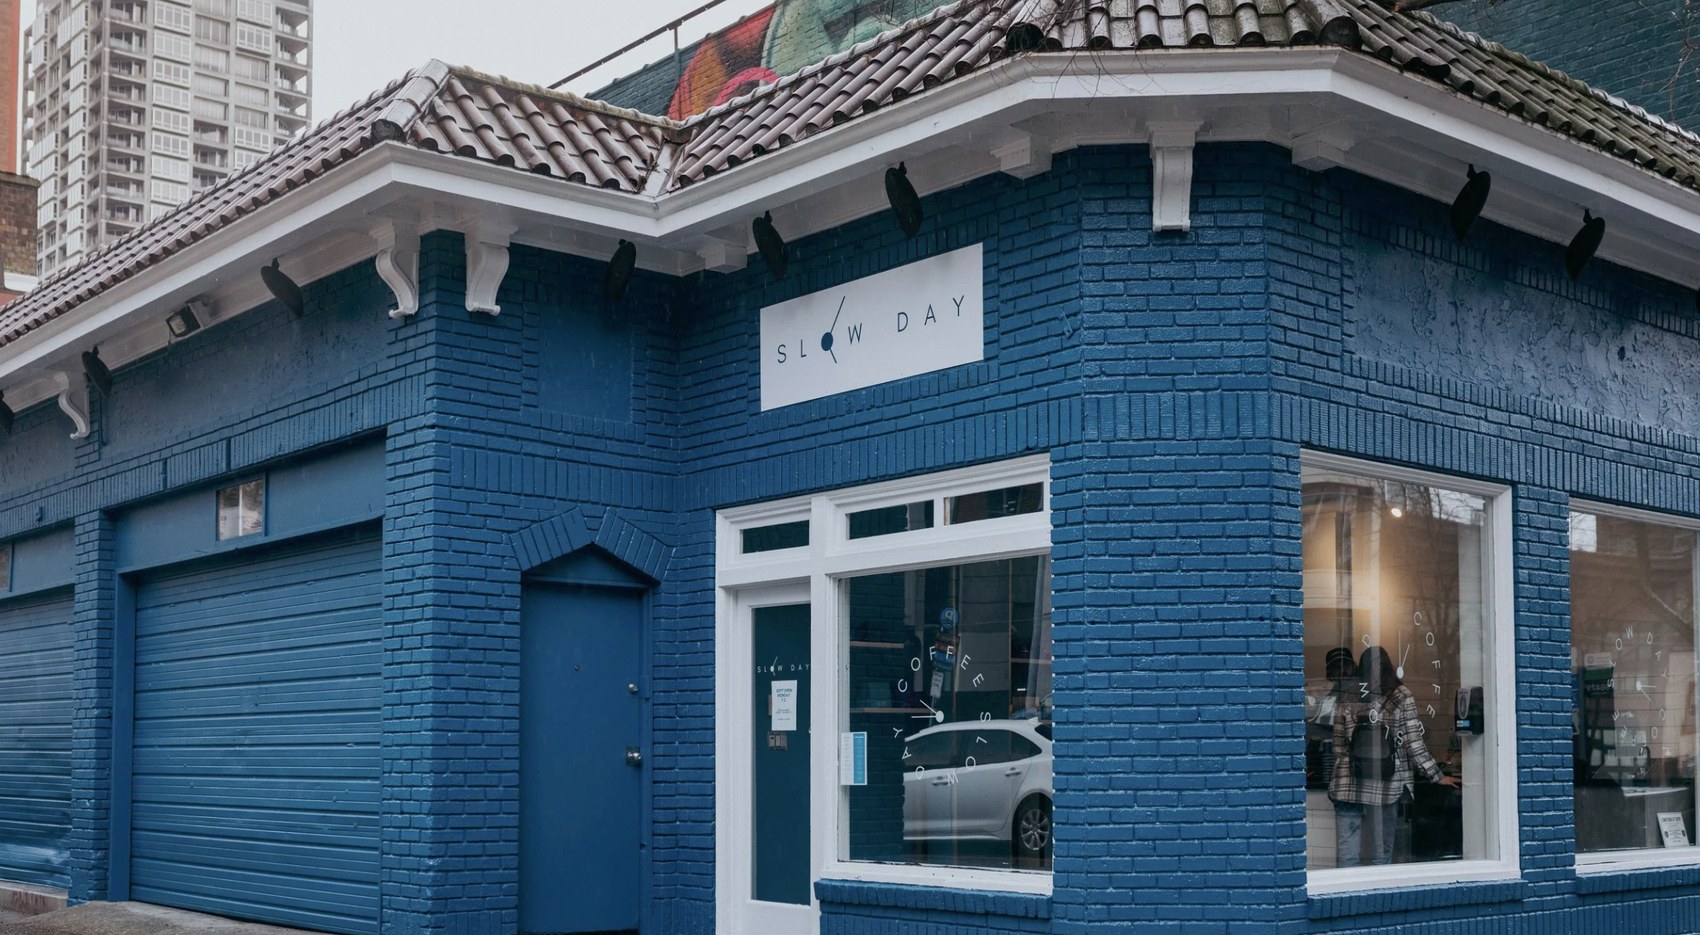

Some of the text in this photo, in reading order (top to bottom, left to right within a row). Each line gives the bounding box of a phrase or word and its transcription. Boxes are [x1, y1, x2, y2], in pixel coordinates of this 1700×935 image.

[777, 295, 965, 364] SLOW DAY
[757, 656, 810, 677] SLOW DAY
[897, 645, 985, 693] COFFEE
[1414, 611, 1441, 737] COFFEE
[1646, 631, 1668, 680] DAY
[1359, 682, 1404, 746] SLOW
[892, 727, 925, 780] DAY
[946, 711, 992, 787] SLOW
